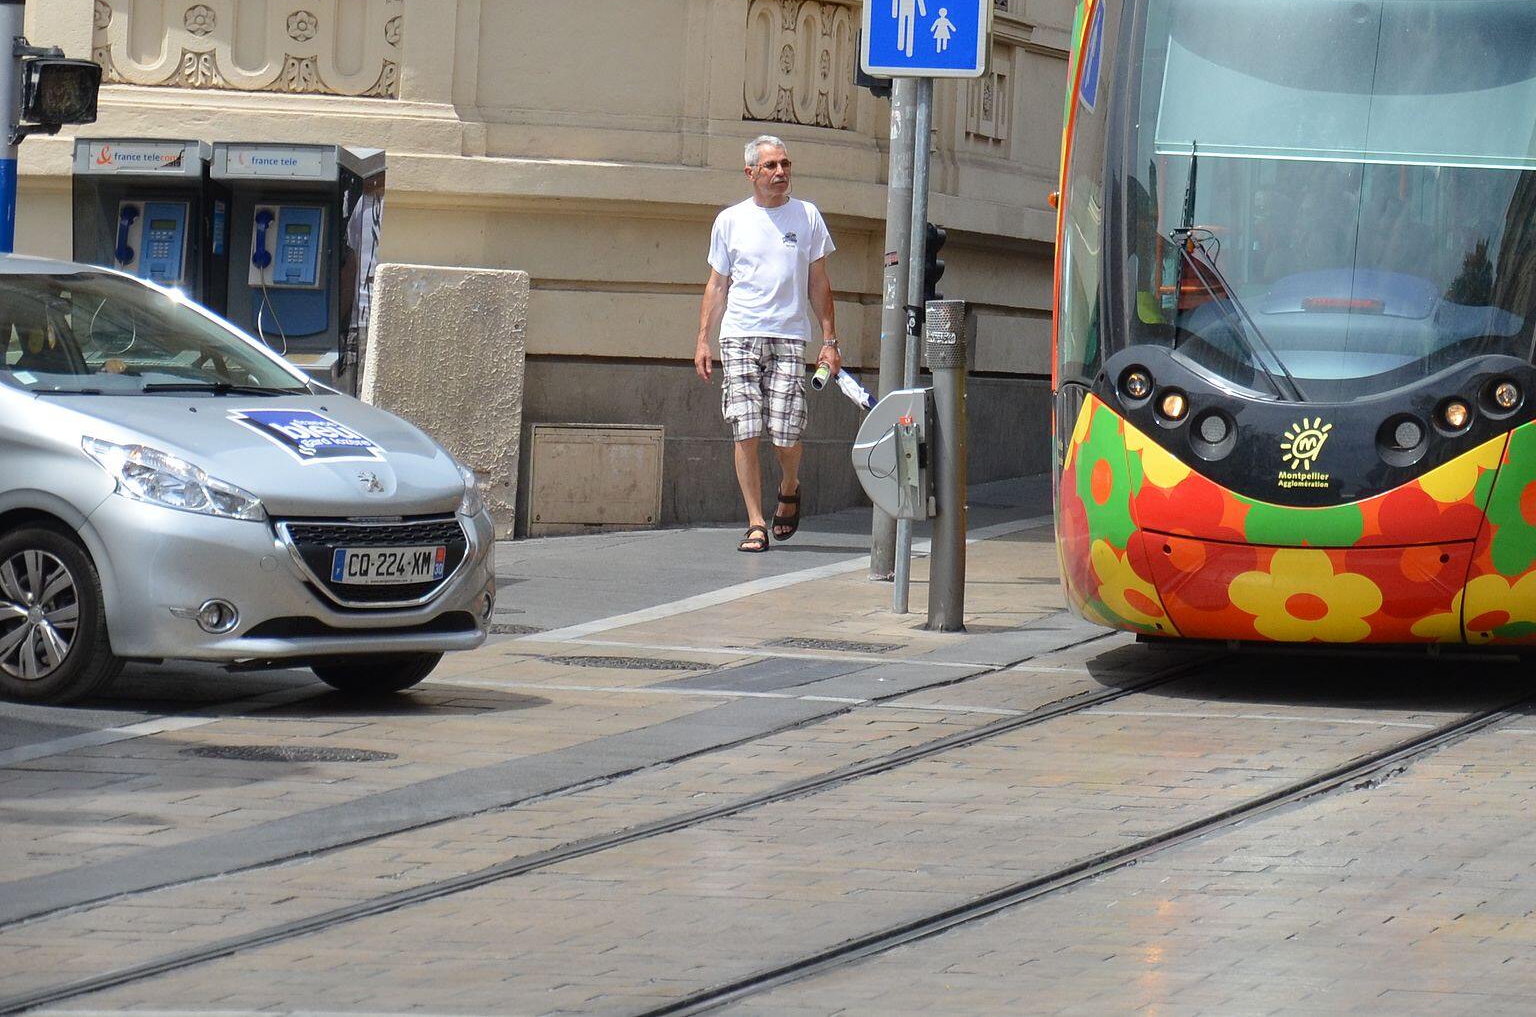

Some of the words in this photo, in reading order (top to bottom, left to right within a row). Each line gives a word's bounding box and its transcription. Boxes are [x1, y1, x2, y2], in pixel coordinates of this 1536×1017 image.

[114, 152, 142, 161] france
[251, 157, 278, 166] france
[1278, 471, 1329, 481] Montpellier
[1278, 480, 1329, 488] Agglomération
[348, 551, 432, 577] CQ-224-XM
